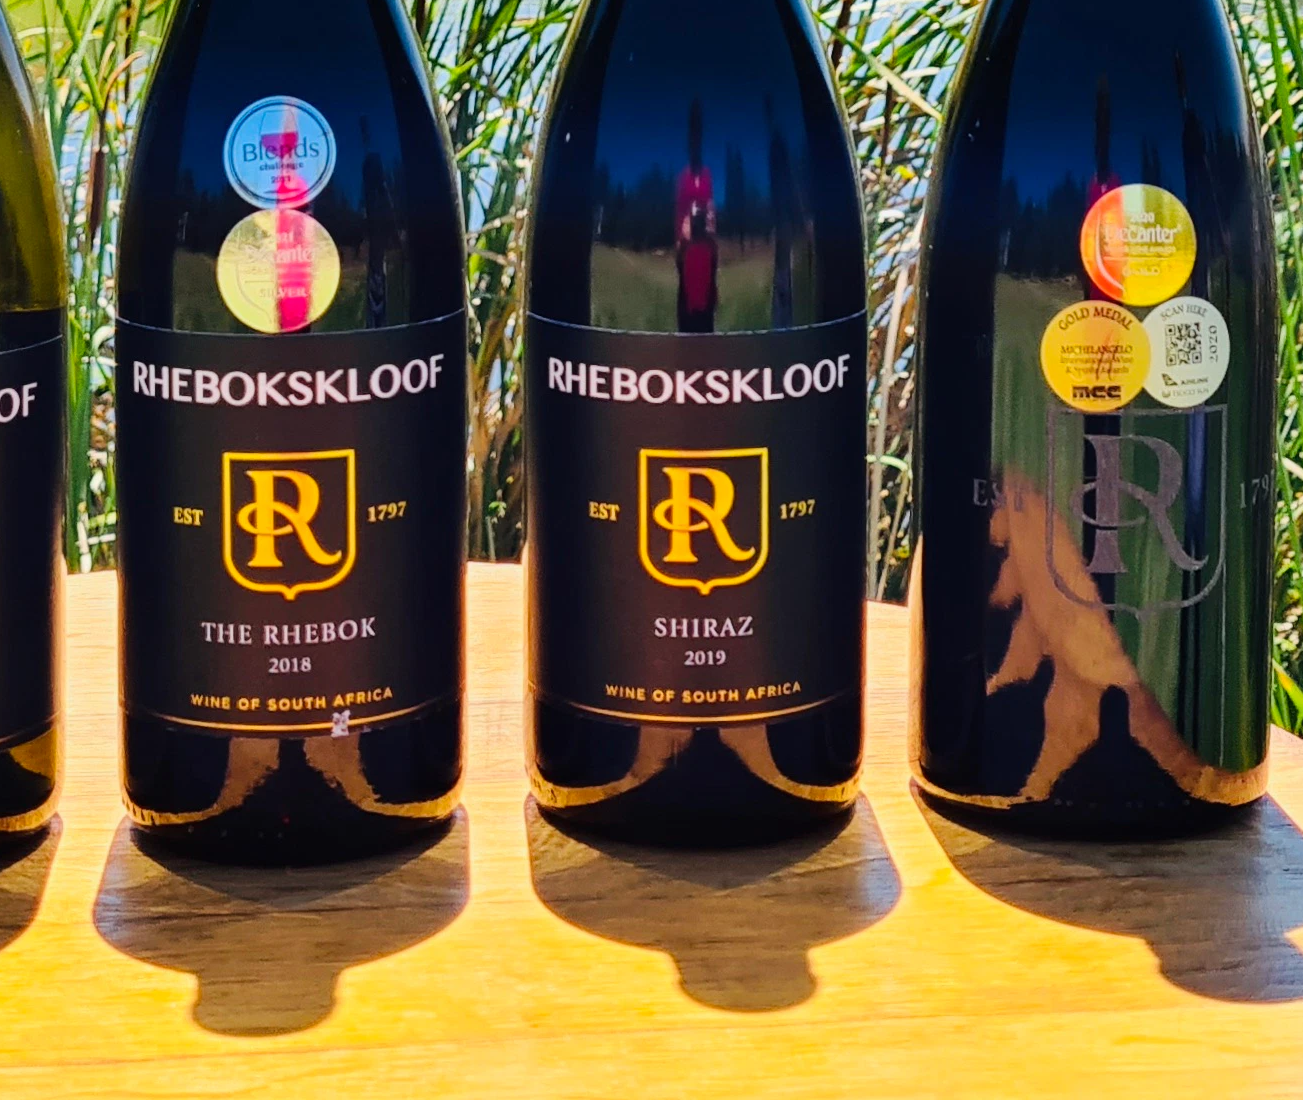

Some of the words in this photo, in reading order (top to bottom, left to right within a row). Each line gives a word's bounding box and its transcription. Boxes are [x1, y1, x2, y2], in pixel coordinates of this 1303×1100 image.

[242, 136, 320, 162] Blends
[260, 286, 308, 299] SILVER
[1058, 306, 1090, 331] GOLD
[1093, 305, 1134, 331] MEDAL
[1160, 304, 1185, 321] SCAN
[1186, 304, 1209, 317] HERE
[1060, 345, 1134, 355] MICHELANGELO
[133, 353, 445, 407] RHEBOKSKLOOF
[547, 353, 851, 405] RHEBOKSKLOOF
[173, 506, 204, 527] EST
[367, 500, 407, 523] 1797
[236, 470, 343, 568] R
[588, 500, 621, 522] EST
[779, 499, 816, 520] 1797
[652, 466, 756, 563] R
[201, 620, 253, 645] THE
[264, 616, 378, 646] RHEBOK
[653, 615, 755, 639] SHIRAZ
[268, 657, 313, 674] 2018
[683, 650, 728, 667] 2019
[189, 692, 232, 711] WINE
[237, 696, 262, 712] OF
[267, 694, 327, 712] SOUTH
[332, 686, 394, 708] AFRICA
[604, 683, 647, 701] WINE
[652, 687, 675, 703] OF
[682, 685, 739, 703] SOUTH
[745, 680, 802, 701] AFRICA
